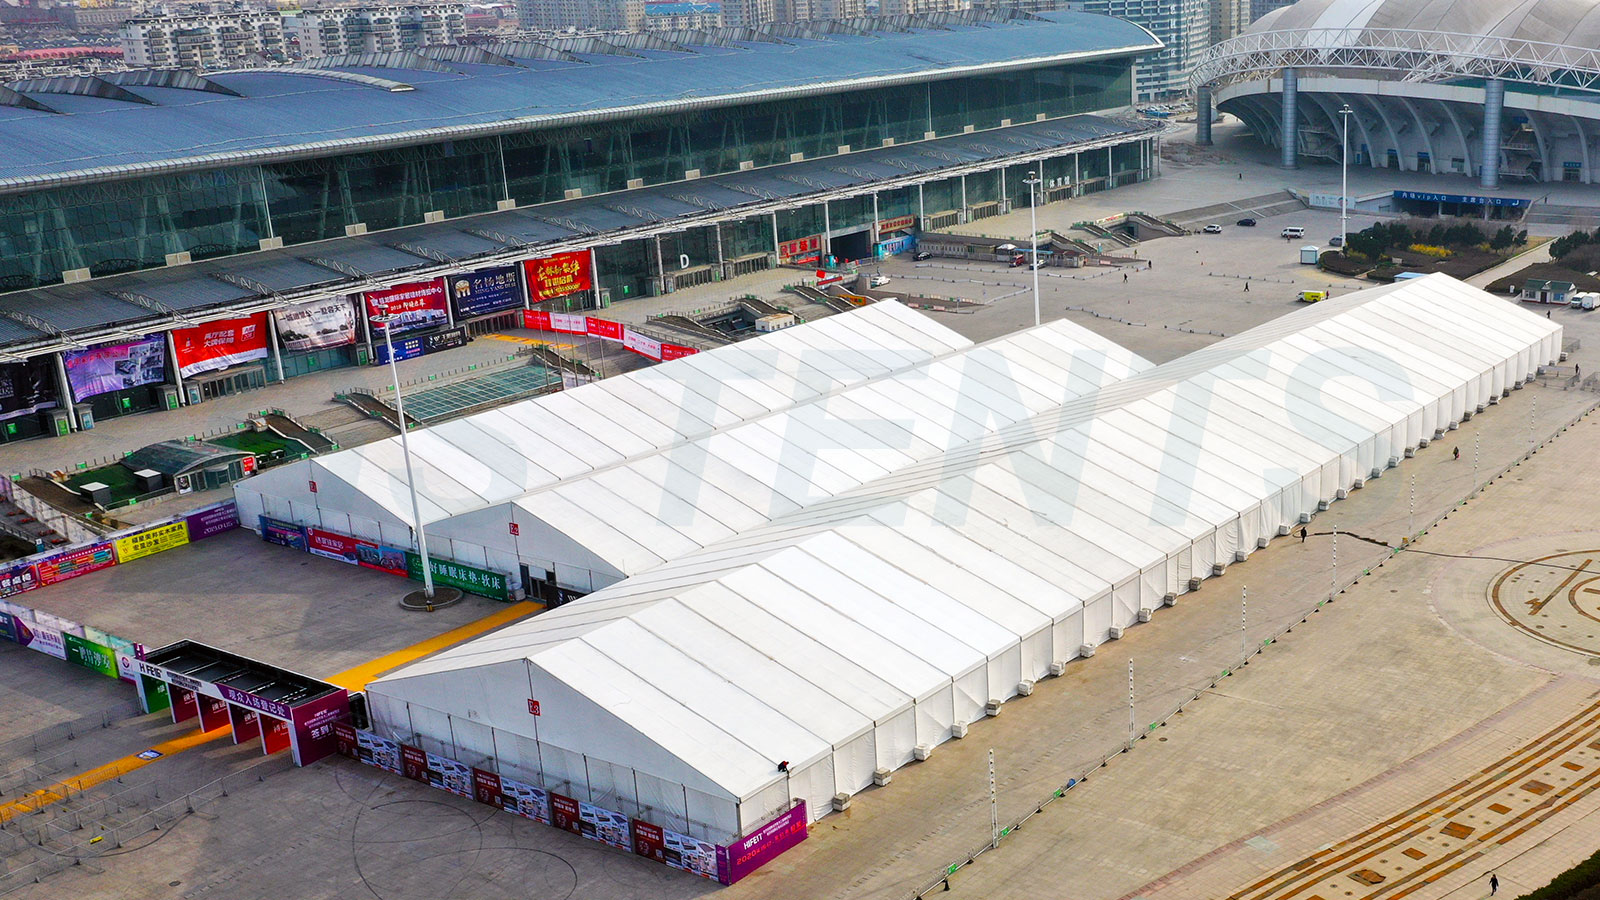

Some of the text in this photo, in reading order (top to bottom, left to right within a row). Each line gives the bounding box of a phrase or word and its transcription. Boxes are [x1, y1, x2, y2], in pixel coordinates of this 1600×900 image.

[680, 253, 690, 270] D
[228, 688, 286, 717] 观众入场登记处
